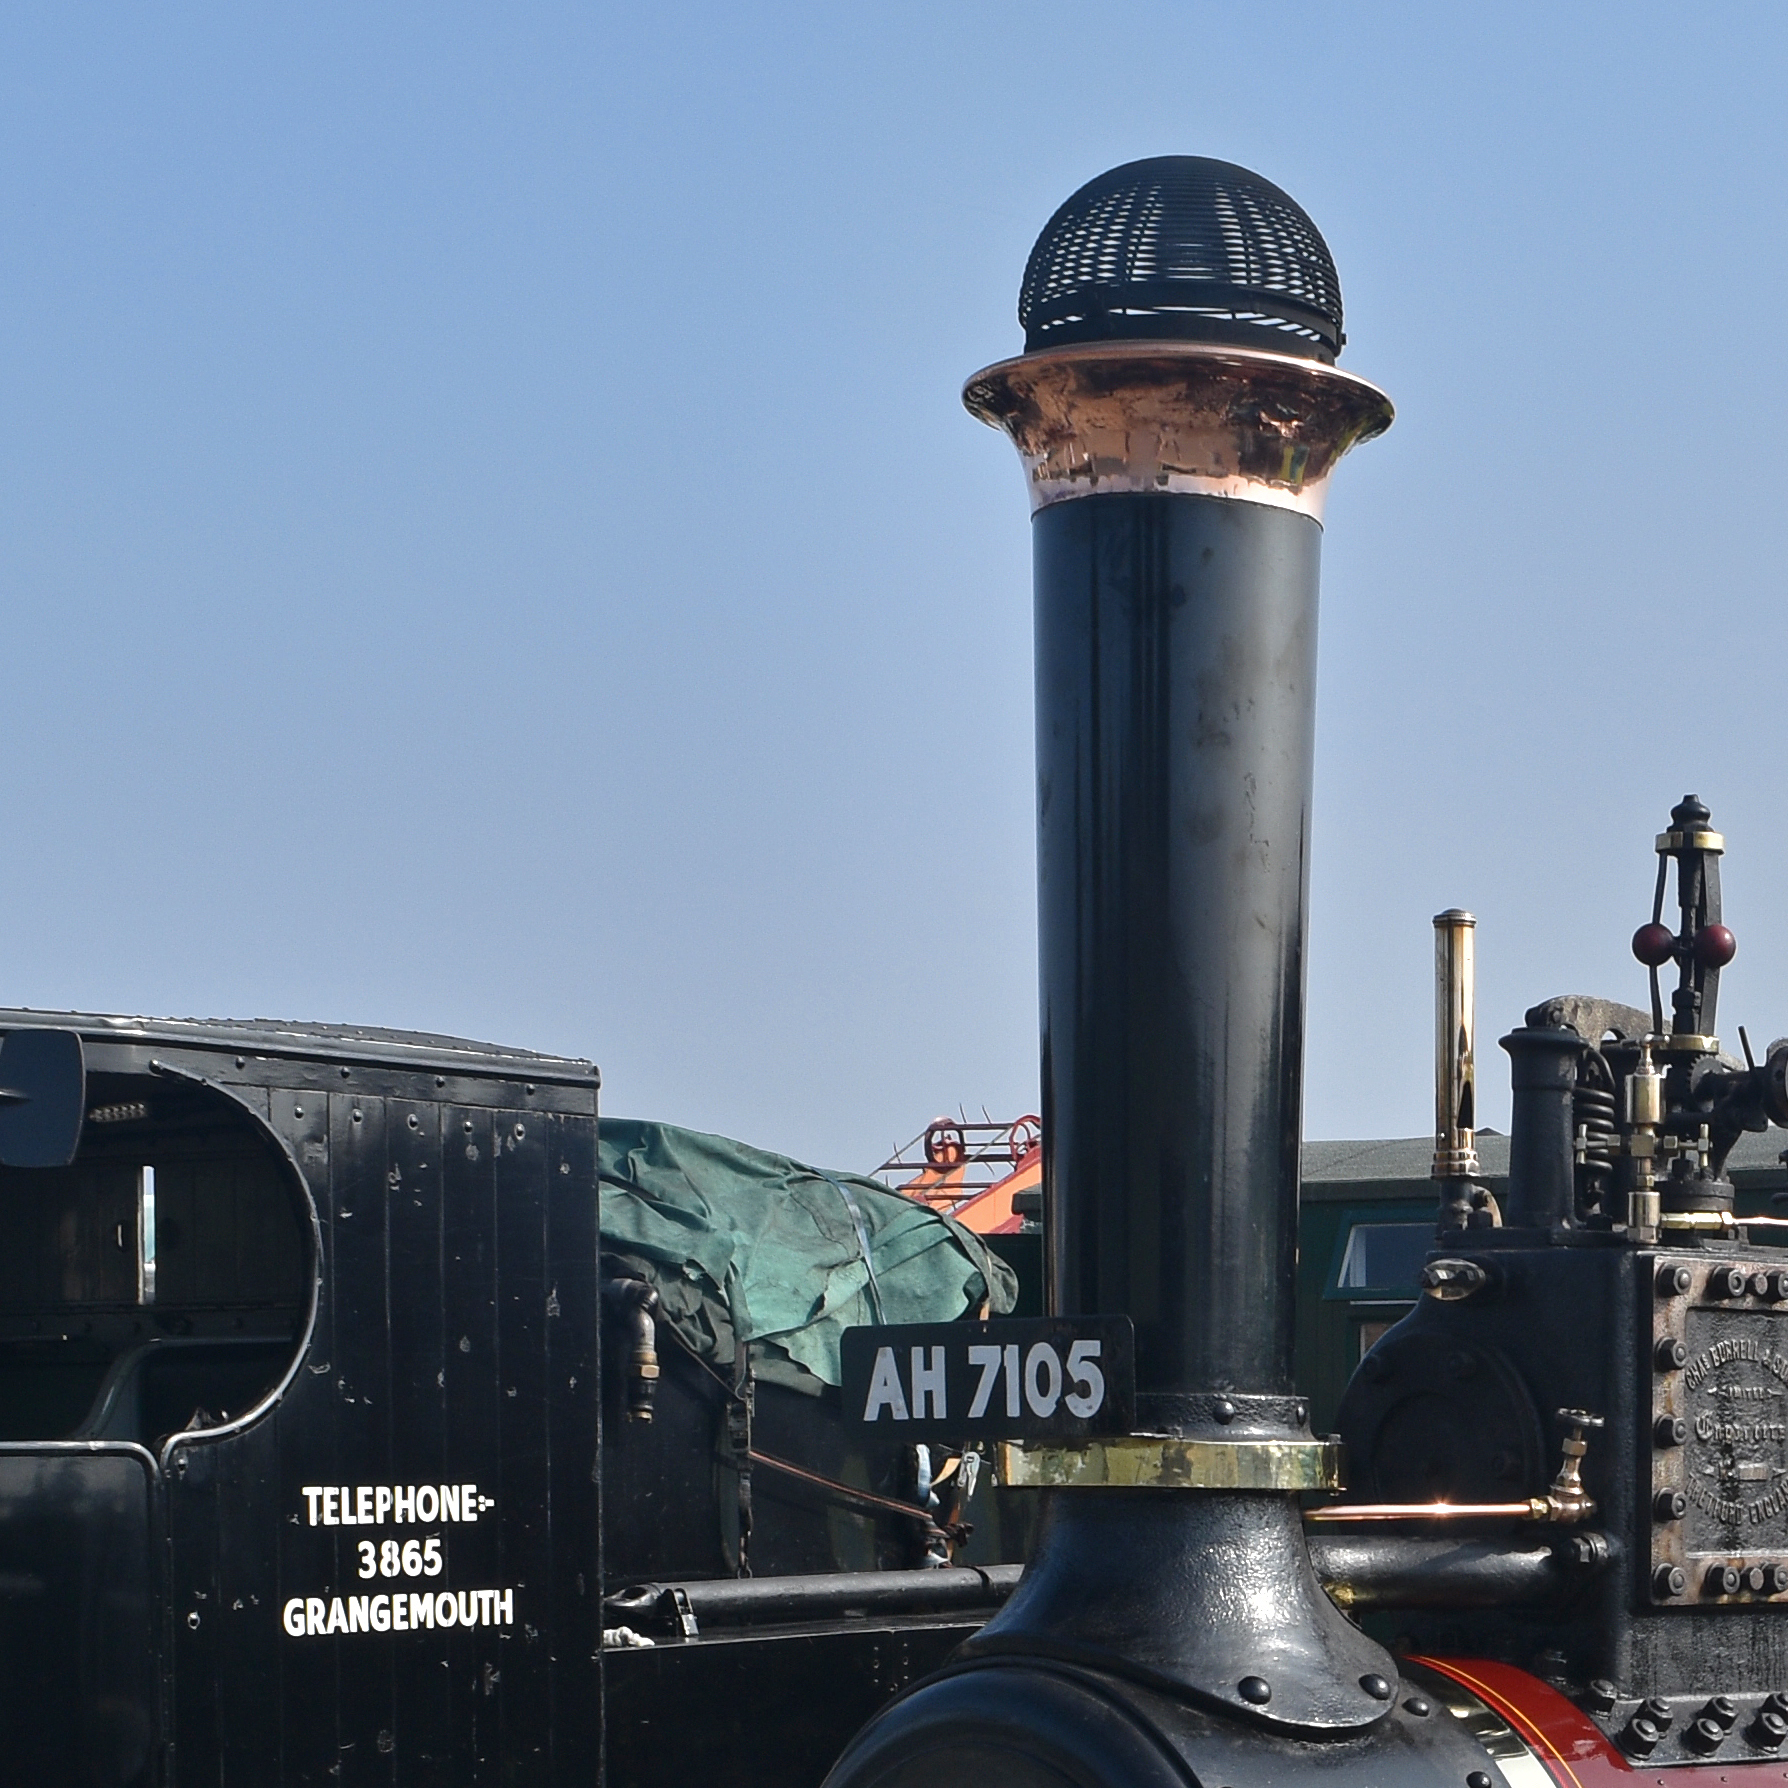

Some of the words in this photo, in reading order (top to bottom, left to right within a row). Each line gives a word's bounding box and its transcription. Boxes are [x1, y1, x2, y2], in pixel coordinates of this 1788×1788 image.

[863, 1346, 947, 1421] AH
[967, 1339, 1105, 1418] 7105
[357, 1539, 443, 1579] 3865
[283, 1588, 514, 1637] GRANGEMOUTH
